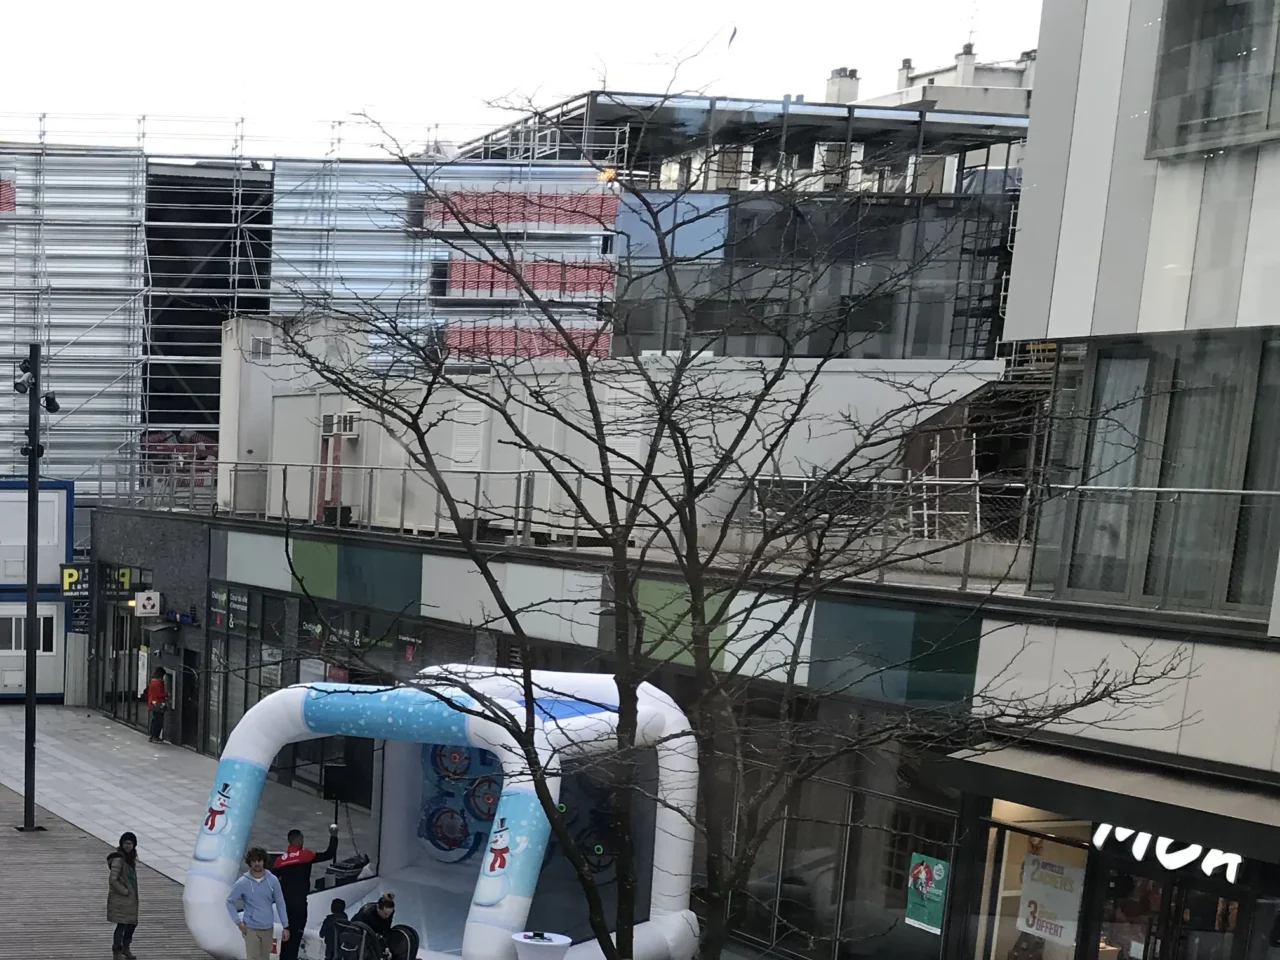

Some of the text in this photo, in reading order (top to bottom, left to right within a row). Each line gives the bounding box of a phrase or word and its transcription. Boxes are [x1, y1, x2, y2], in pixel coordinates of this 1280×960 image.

[63, 568, 79, 590] P
[1025, 900, 1038, 928] 3
[1036, 919, 1065, 938] OFFERT
